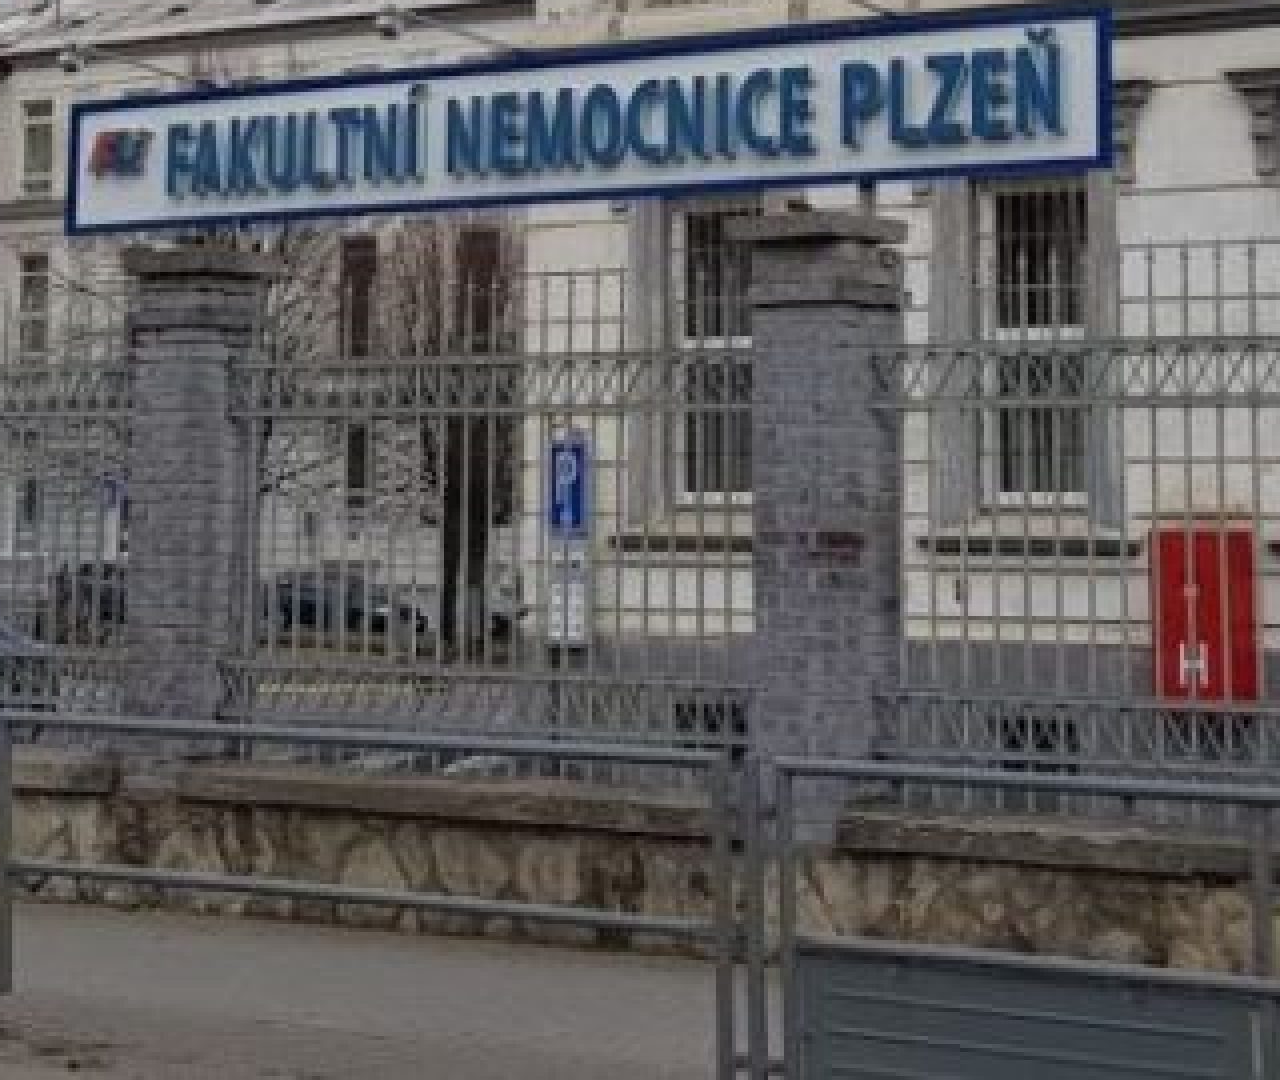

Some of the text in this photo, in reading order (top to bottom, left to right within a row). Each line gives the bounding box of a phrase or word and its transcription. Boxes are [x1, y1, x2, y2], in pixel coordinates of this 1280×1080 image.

[163, 84, 426, 200] FAKULTNÍ
[445, 63, 817, 180] NEMOCNICE
[839, 27, 1068, 152] PLZEŇ
[1179, 639, 1209, 689] H
